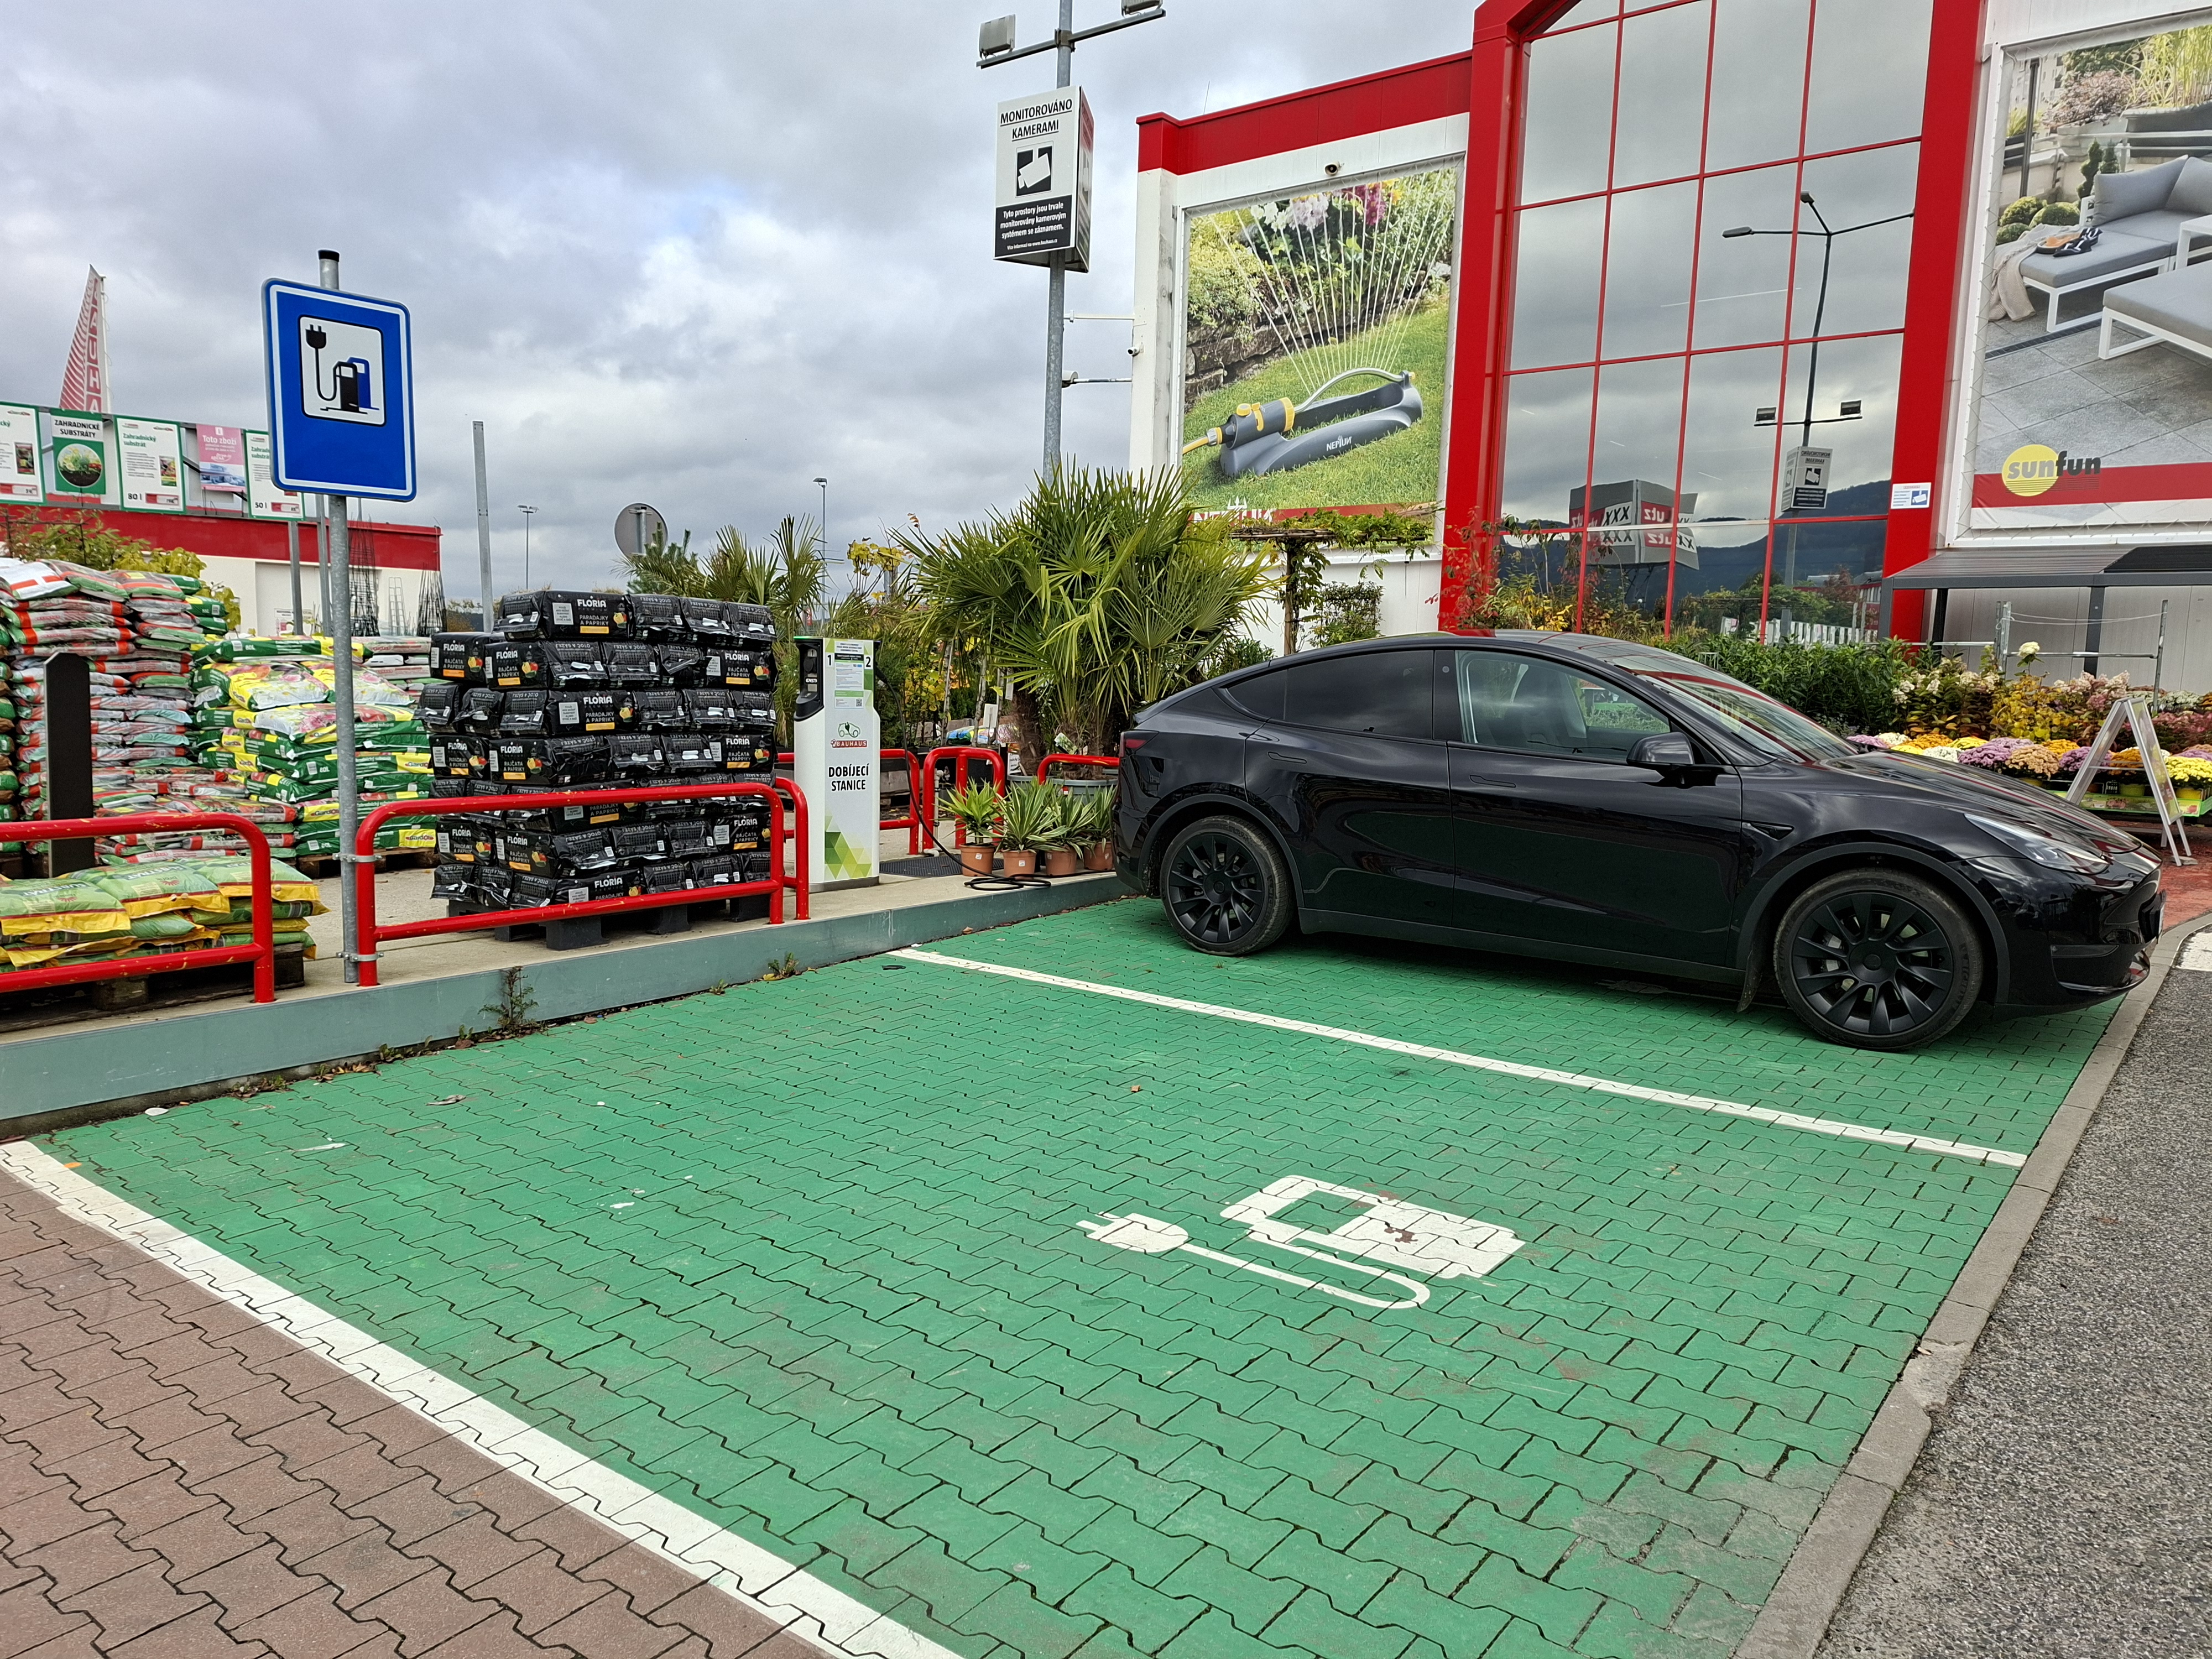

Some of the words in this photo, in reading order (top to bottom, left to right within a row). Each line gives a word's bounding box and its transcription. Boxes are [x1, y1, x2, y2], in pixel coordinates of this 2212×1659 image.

[1000, 98, 1072, 124] MONITOROVÁNO
[1012, 119, 1059, 139] KAMERAMI
[1003, 210, 1014, 219] Tyto
[1015, 207, 1036, 218] prostory
[1036, 205, 1047, 214] jsou
[1048, 201, 1064, 211] trvale
[1000, 217, 1035, 229] monitorovány
[1036, 212, 1067, 223] kamerovým
[1001, 229, 1027, 240] systémem
[1034, 223, 1064, 234] záznamem.
[54, 419, 100, 430] ZAHRADNICKÉ
[60, 429, 96, 437] SUBSTRÁTY
[220, 436, 237, 445] zboží
[1326, 435, 1352, 451] NEPTUN
[2007, 450, 2101, 479] sunfun
[577, 598, 607, 608] FLORIA
[444, 643, 465, 652] FLORIA
[496, 650, 518, 659] FLORIA
[725, 653, 750, 661] FLORIA
[827, 654, 831, 666] 1
[865, 656, 872, 667] 2
[583, 696, 613, 705] FLORIA
[447, 742, 467, 750] FLORIA
[828, 763, 869, 778] DOBÍJECÍ
[831, 779, 866, 791] STANICE
[734, 818, 758, 827] FLORIA
[452, 829, 471, 837] FLORIA
[507, 836, 528, 846] FLORIA
[594, 878, 623, 889] FLORIA
[596, 891, 624, 900] PARADAJKY
